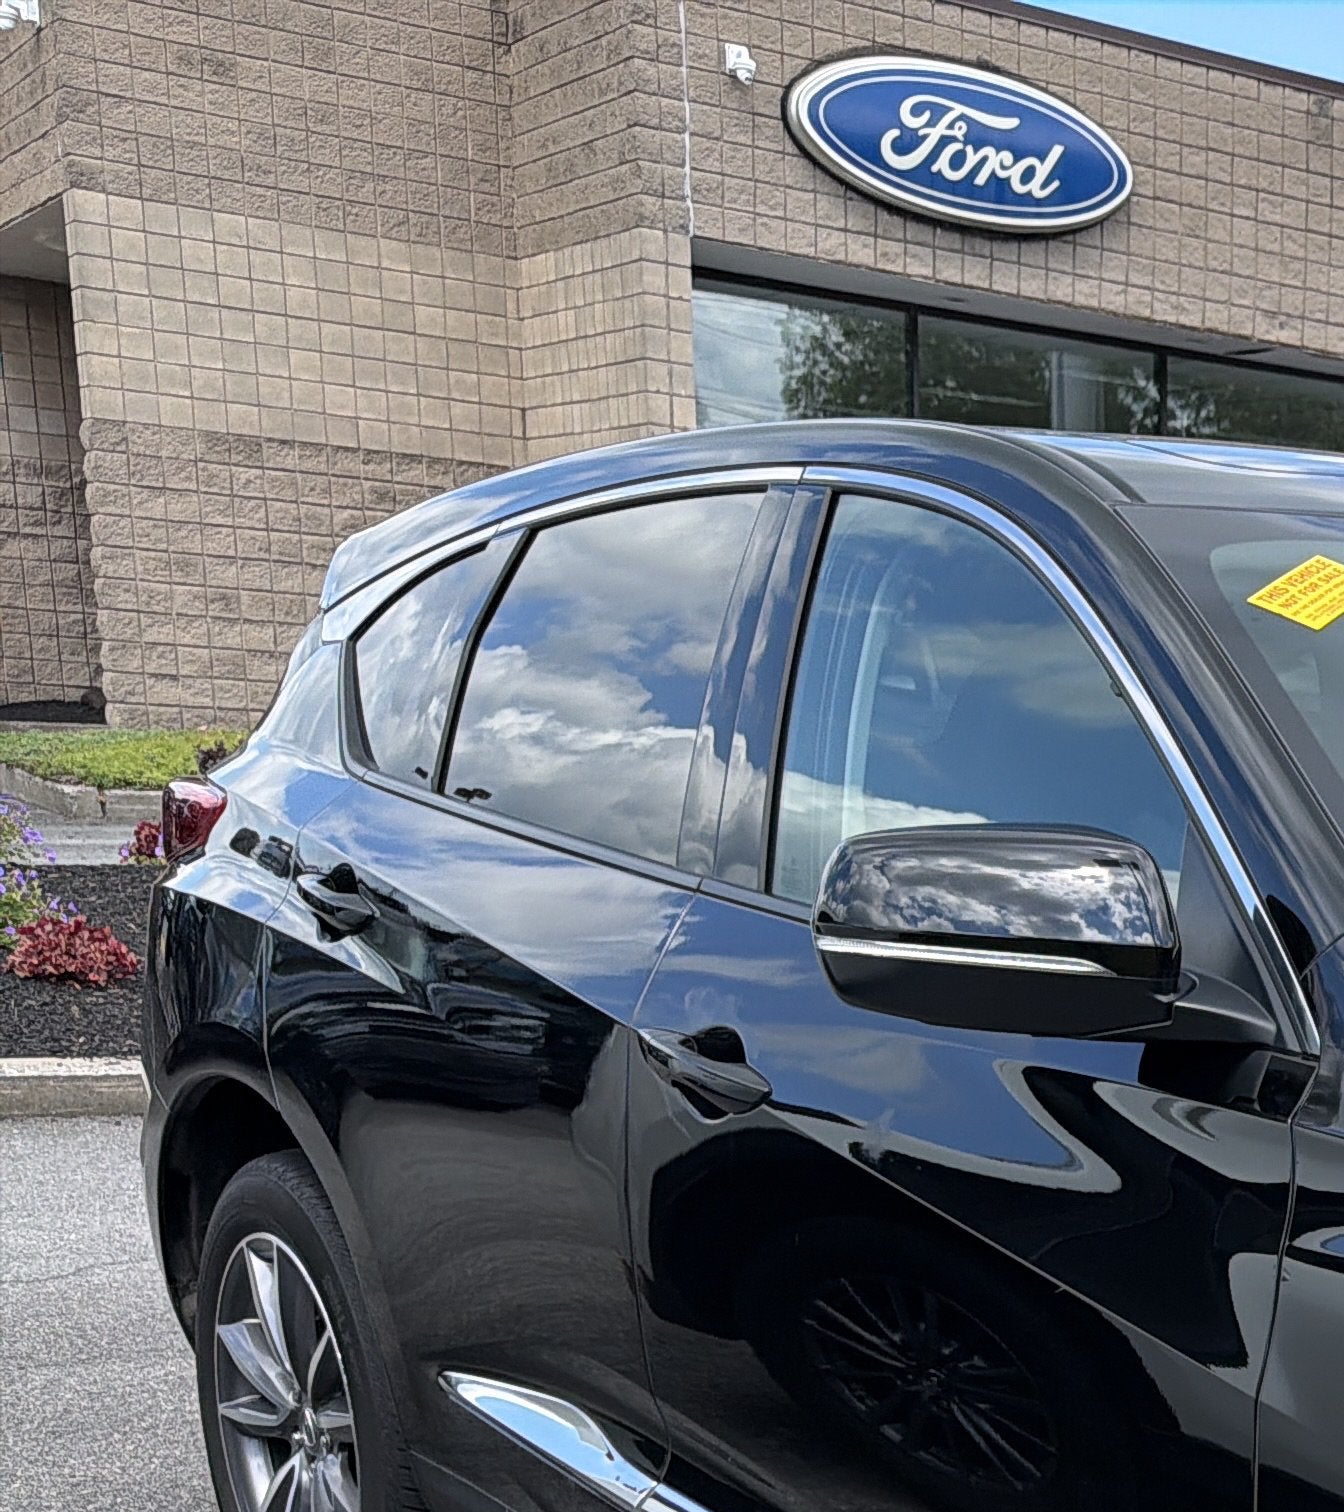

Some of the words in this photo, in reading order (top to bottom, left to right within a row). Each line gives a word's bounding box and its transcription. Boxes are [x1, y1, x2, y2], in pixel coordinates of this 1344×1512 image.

[880, 94, 1065, 199] Ford
[1256, 586, 1290, 604] THIS
[1281, 559, 1332, 587] VEHICLE
[1278, 594, 1302, 610] NOT
[1298, 582, 1323, 596] FOR
[1317, 568, 1344, 584] SALE
